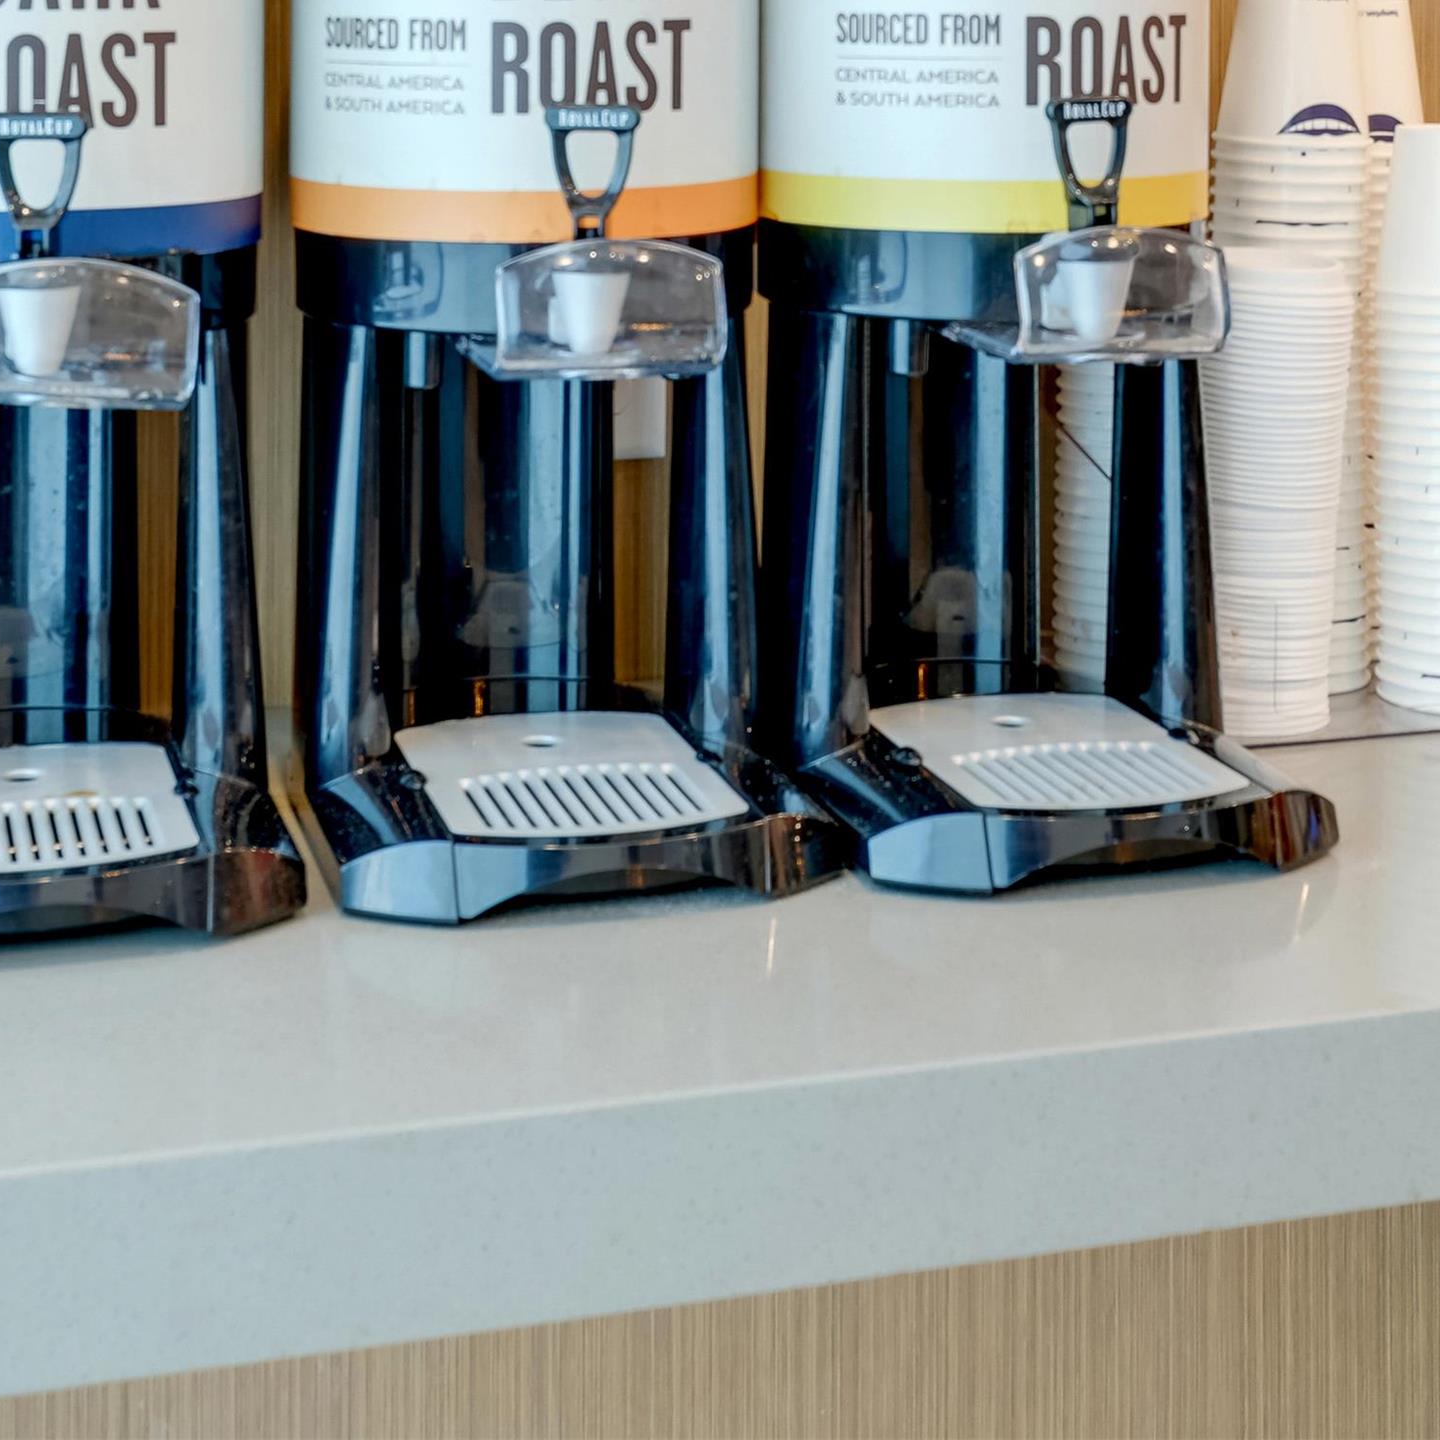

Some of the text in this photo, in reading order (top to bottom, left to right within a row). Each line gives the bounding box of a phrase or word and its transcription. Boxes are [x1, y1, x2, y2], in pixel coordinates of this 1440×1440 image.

[325, 17, 467, 52] SOURCED FROM
[836, 13, 1001, 46] SOURCED FROM
[491, 20, 691, 114] ROAST
[1026, 15, 1187, 106] ROAST
[325, 72, 463, 92] CENTRAL AMERICA
[835, 68, 999, 85] CENTRAL AMERICA
[334, 98, 382, 114] SOUTH
[386, 100, 465, 116] AMERICA
[835, 92, 1000, 108] & SOUTH AMERICA
